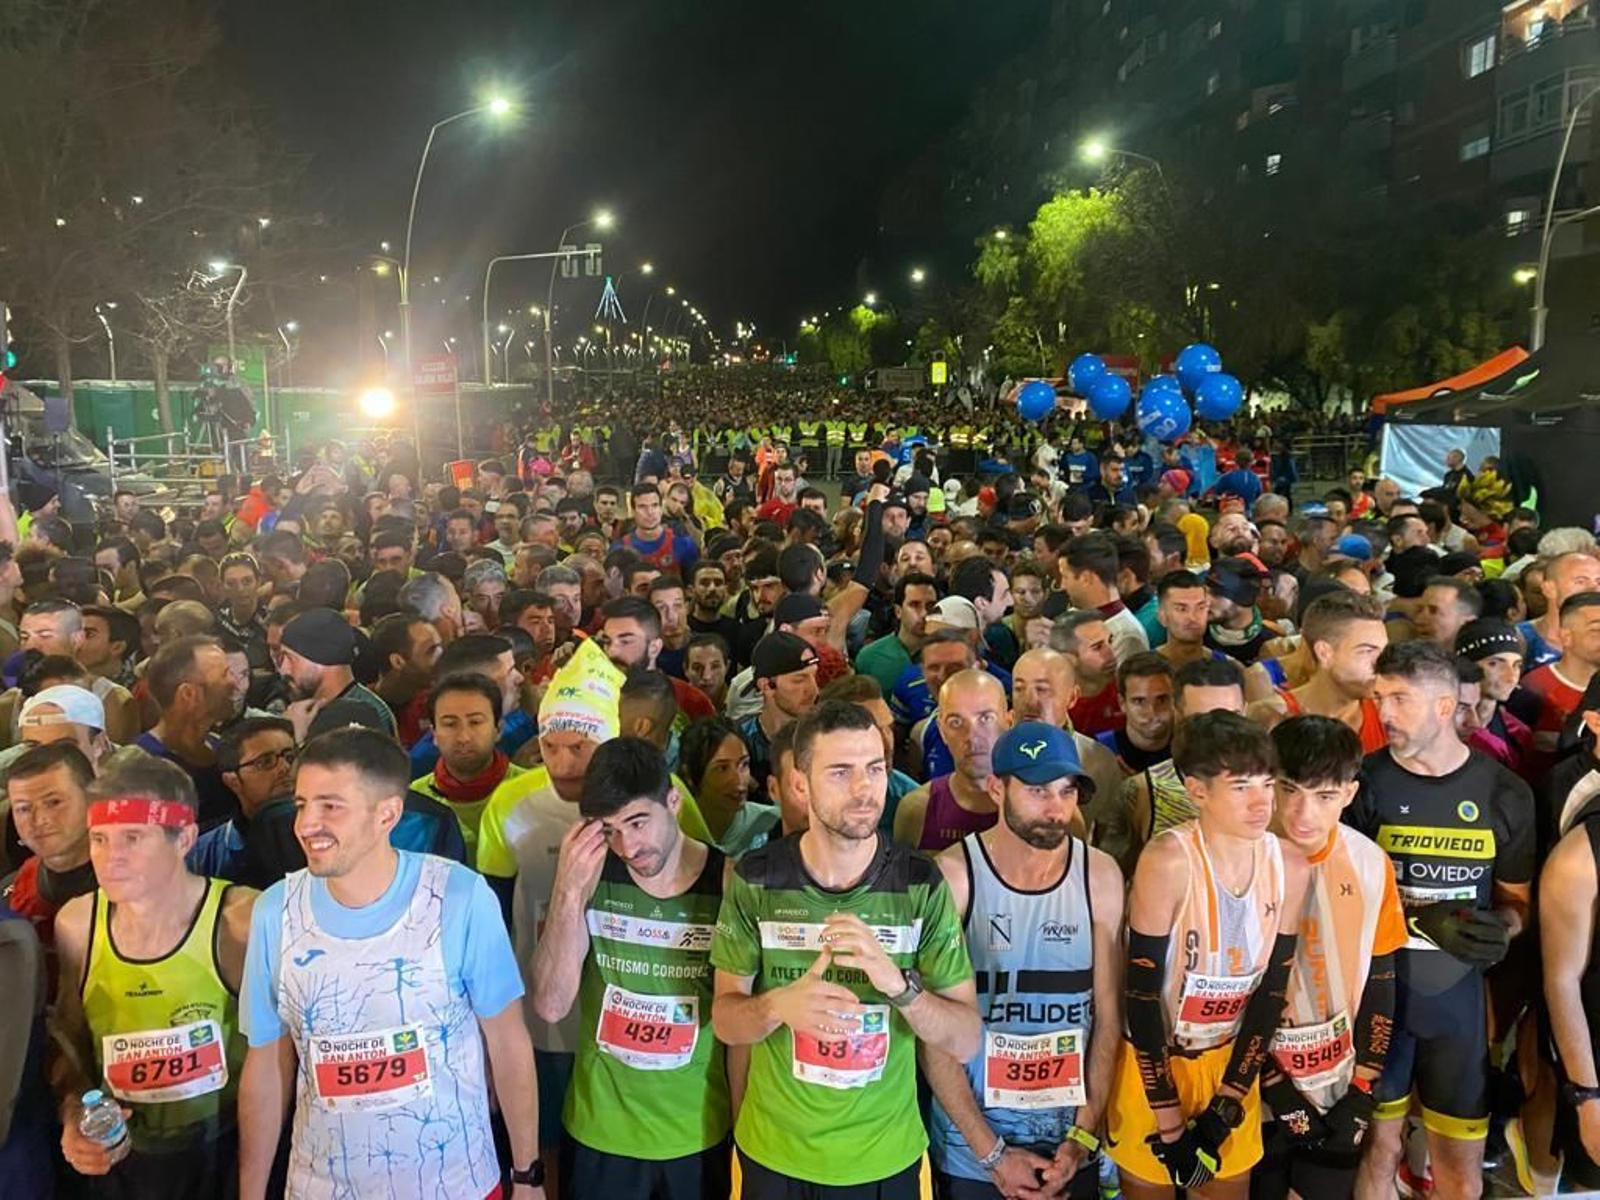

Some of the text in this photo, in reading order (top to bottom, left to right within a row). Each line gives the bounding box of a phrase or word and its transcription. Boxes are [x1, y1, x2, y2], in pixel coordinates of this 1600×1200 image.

[1389, 833, 1484, 852] TRIOVIEDO
[1409, 862, 1484, 882] OVIEDO
[596, 953, 649, 976] ATLETISMO
[611, 1005, 630, 1017] SAN
[622, 1000, 668, 1013] NOCHE DE
[1200, 999, 1244, 1016] 568
[624, 1021, 672, 1046] 434
[1287, 1032, 1317, 1042] NOCHE
[130, 1039, 165, 1049] NOCHE
[166, 1036, 180, 1045] DE
[333, 1041, 369, 1052] NOCHE
[371, 1037, 385, 1049] DE
[1007, 1042, 1038, 1051] NOCHE
[1040, 1039, 1051, 1049] DE
[117, 1051, 142, 1062] SAN
[322, 1053, 345, 1062] SAN
[996, 1049, 1016, 1058] SAN
[1292, 1040, 1342, 1069] 9549
[131, 1052, 202, 1084] 6781
[337, 1057, 407, 1085] 5679
[1006, 1058, 1065, 1082] 3567
